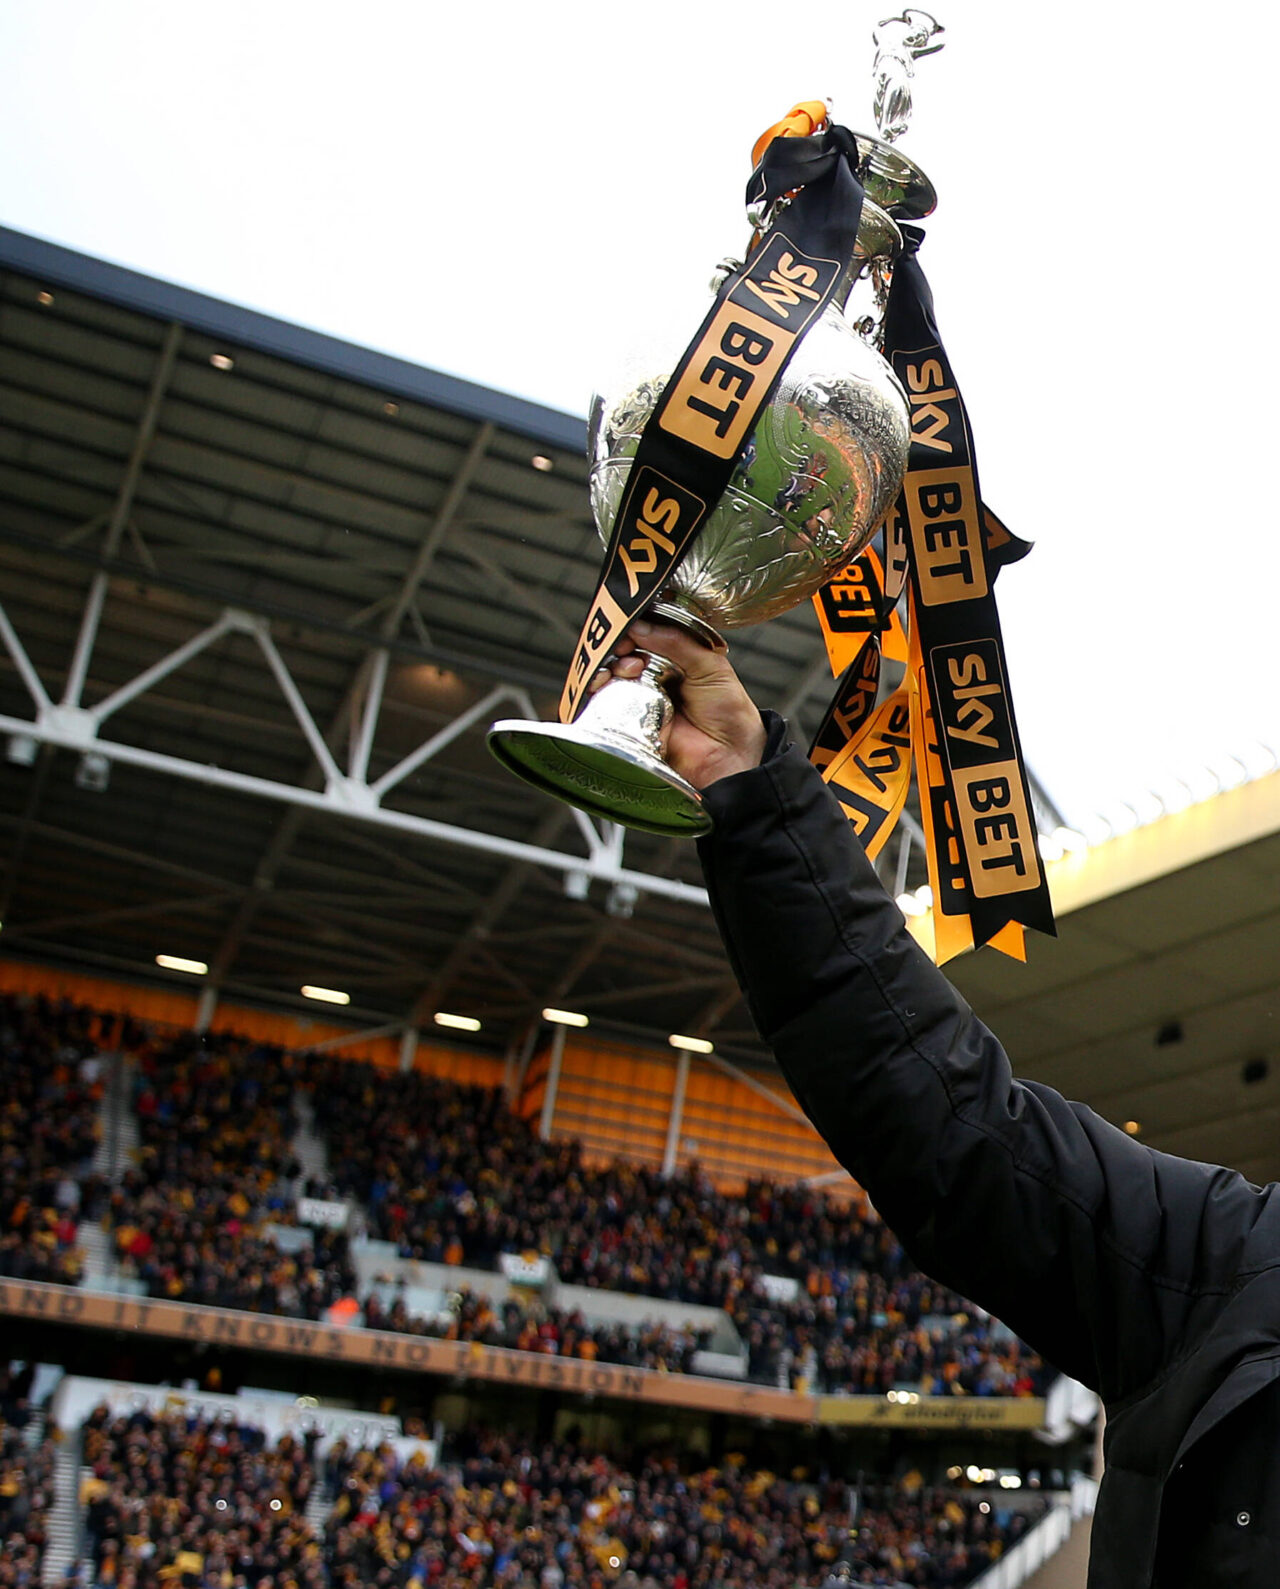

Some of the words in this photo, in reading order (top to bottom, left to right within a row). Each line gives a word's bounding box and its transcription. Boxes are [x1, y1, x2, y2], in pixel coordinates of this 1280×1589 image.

[686, 321, 774, 439] BET
[918, 481, 974, 585] BET
[967, 776, 1026, 876] BET
[0, 1282, 84, 1318] ND
[182, 1308, 345, 1353] KNOWS
[372, 1335, 431, 1367] NO
[457, 1346, 646, 1394] DIVISION
